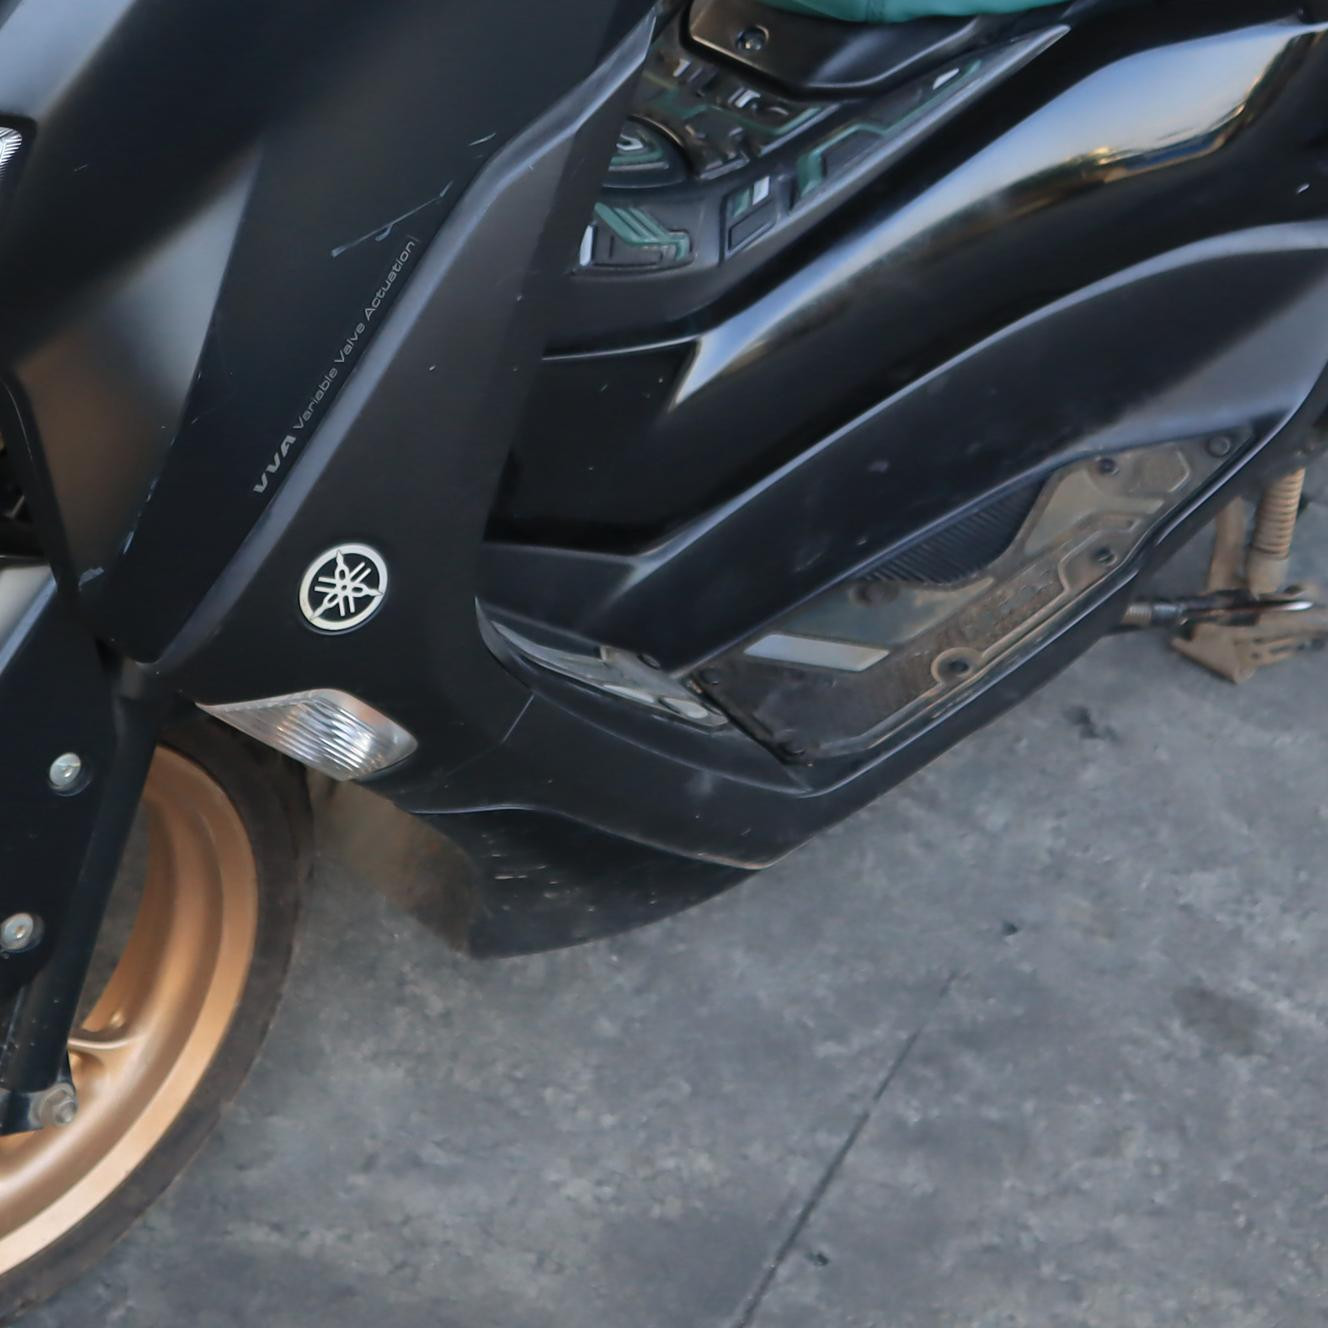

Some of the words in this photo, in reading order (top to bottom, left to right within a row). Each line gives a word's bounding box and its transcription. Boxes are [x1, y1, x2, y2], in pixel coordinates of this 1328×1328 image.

[252, 434, 297, 494] VVA
[292, 366, 339, 431] Variable
[333, 321, 366, 364] Valve
[364, 240, 416, 321] Actuation
